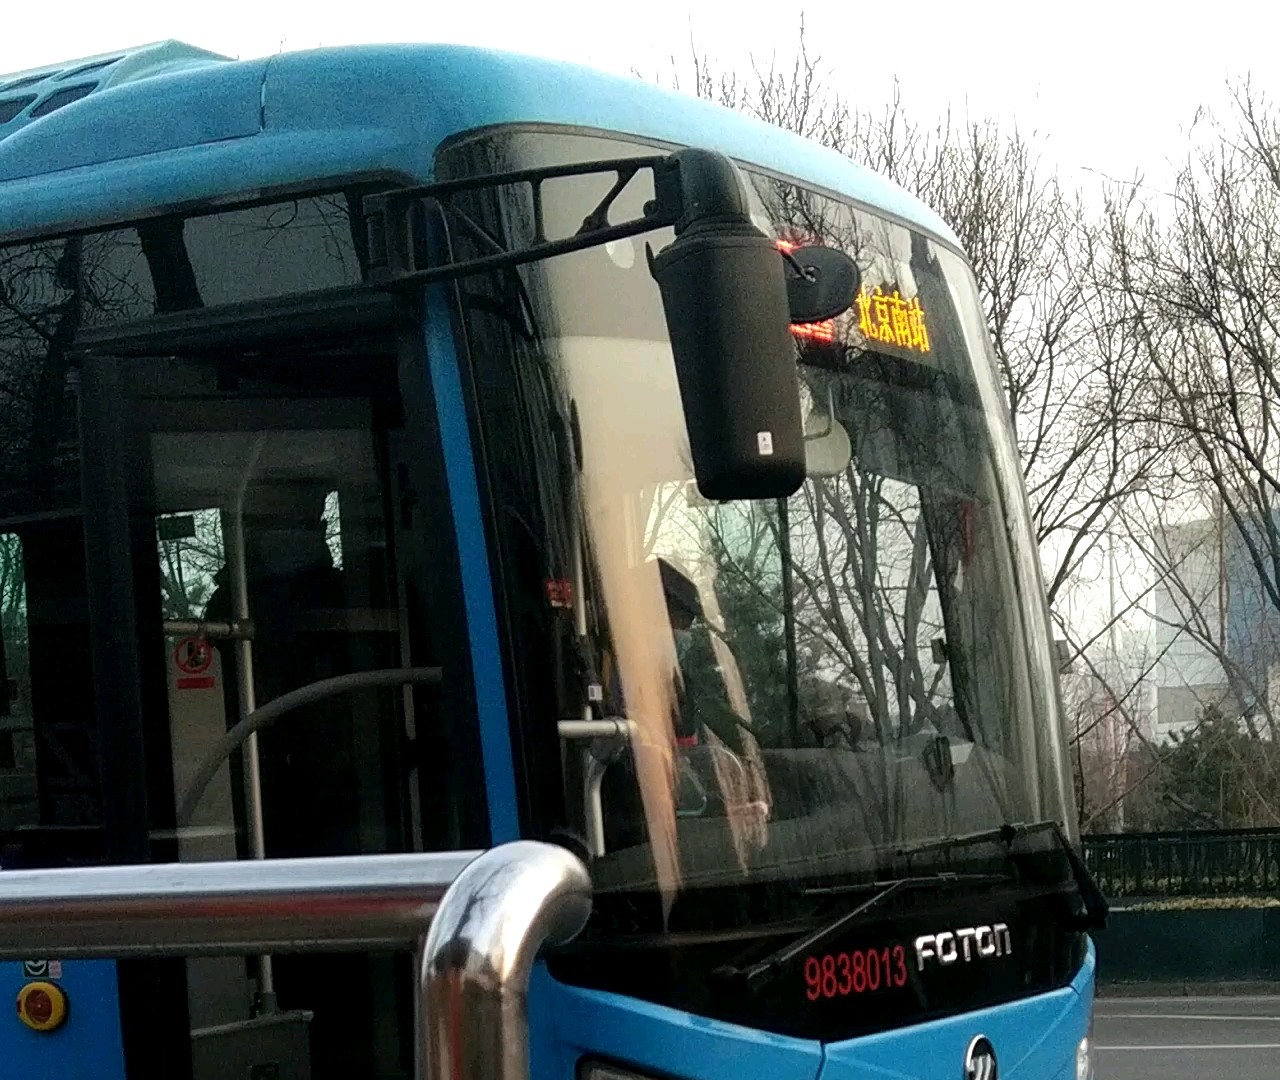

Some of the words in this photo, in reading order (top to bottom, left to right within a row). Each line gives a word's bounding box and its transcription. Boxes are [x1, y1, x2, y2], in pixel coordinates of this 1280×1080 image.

[855, 282, 930, 352] 北京南站
[804, 944, 908, 1001] 9838013
[914, 922, 1013, 972] FOTON
